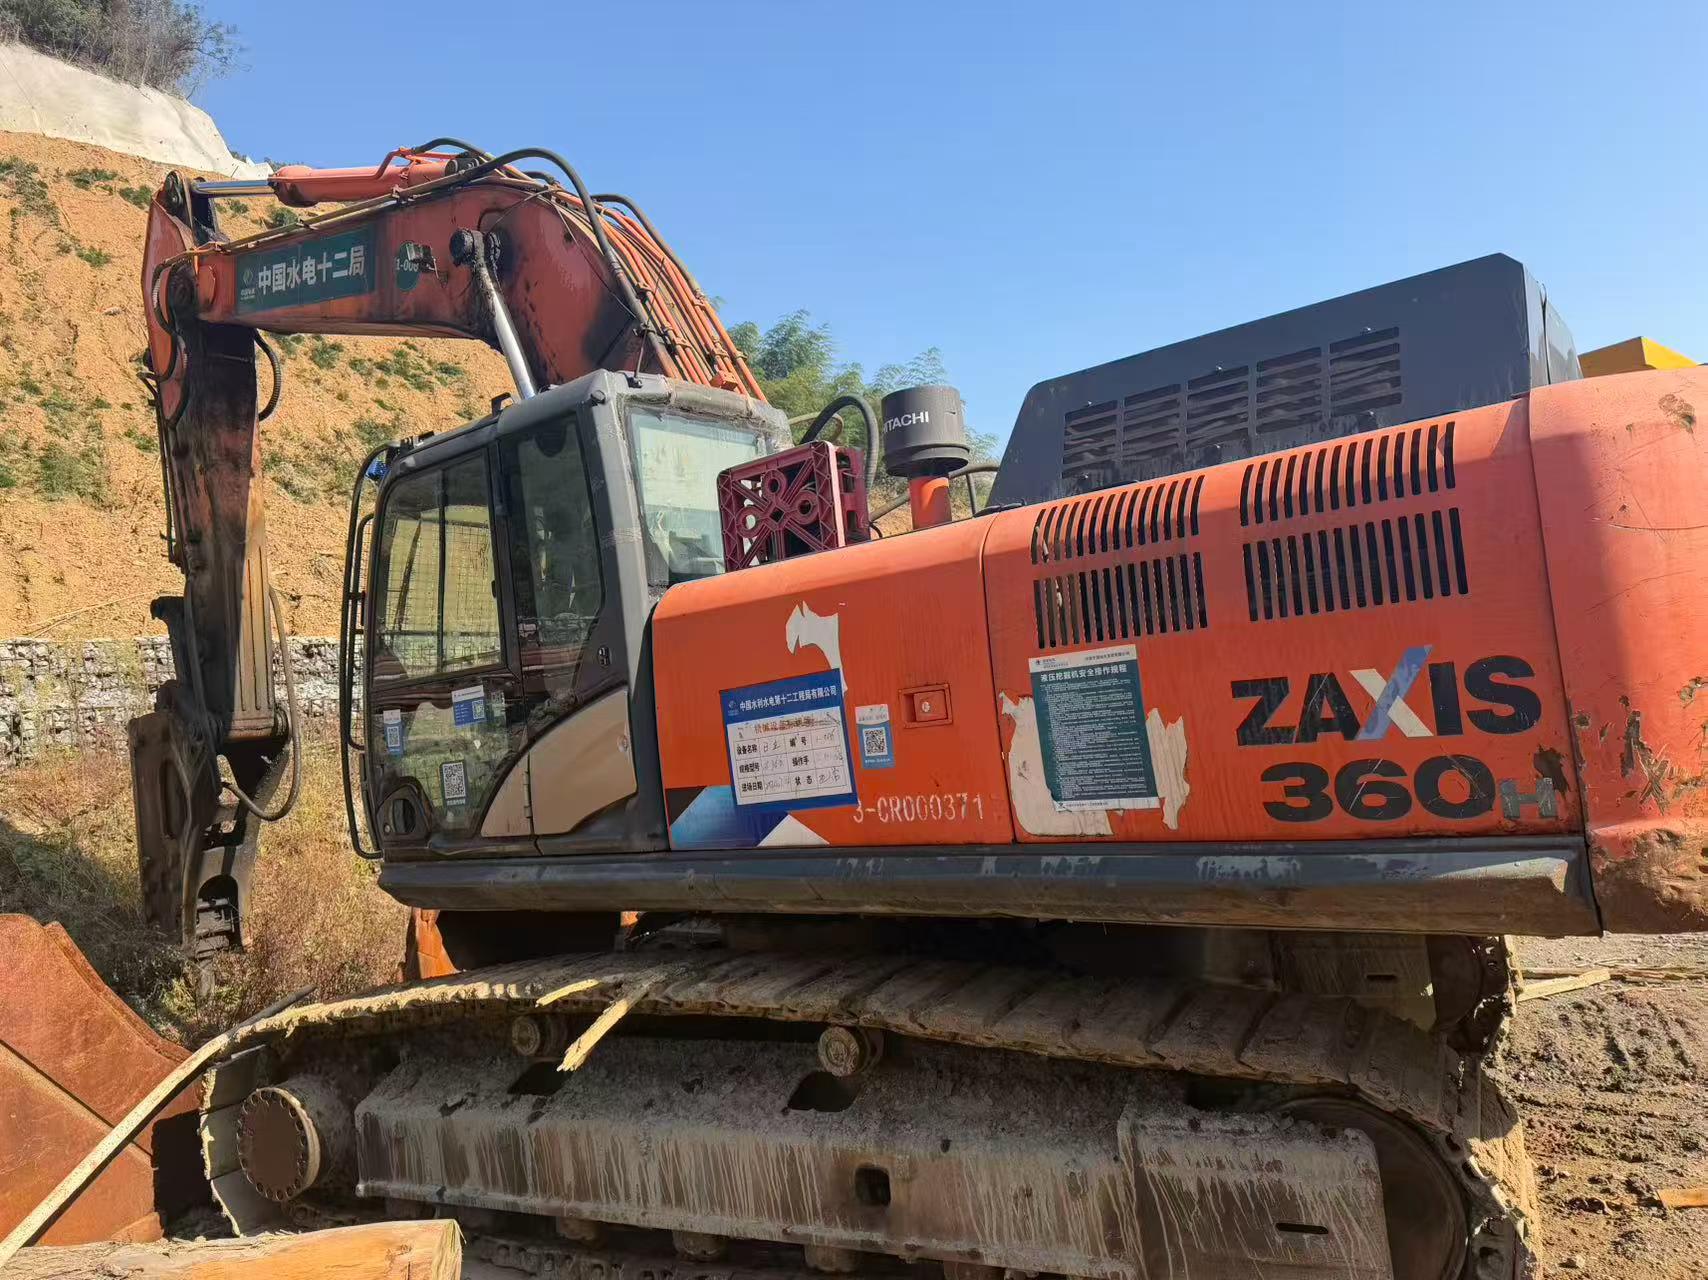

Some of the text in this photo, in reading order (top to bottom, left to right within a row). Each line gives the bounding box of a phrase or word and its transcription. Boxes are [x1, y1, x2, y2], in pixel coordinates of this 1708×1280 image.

[258, 245, 365, 295] 中国水电十二局
[882, 410, 930, 434] ITACHI
[1040, 663, 1128, 683] 液压挖掘机安全操作规程
[739, 685, 838, 712] 中国水利水电第十二工程局有限公司
[1231, 644, 1542, 746] ZAXIS
